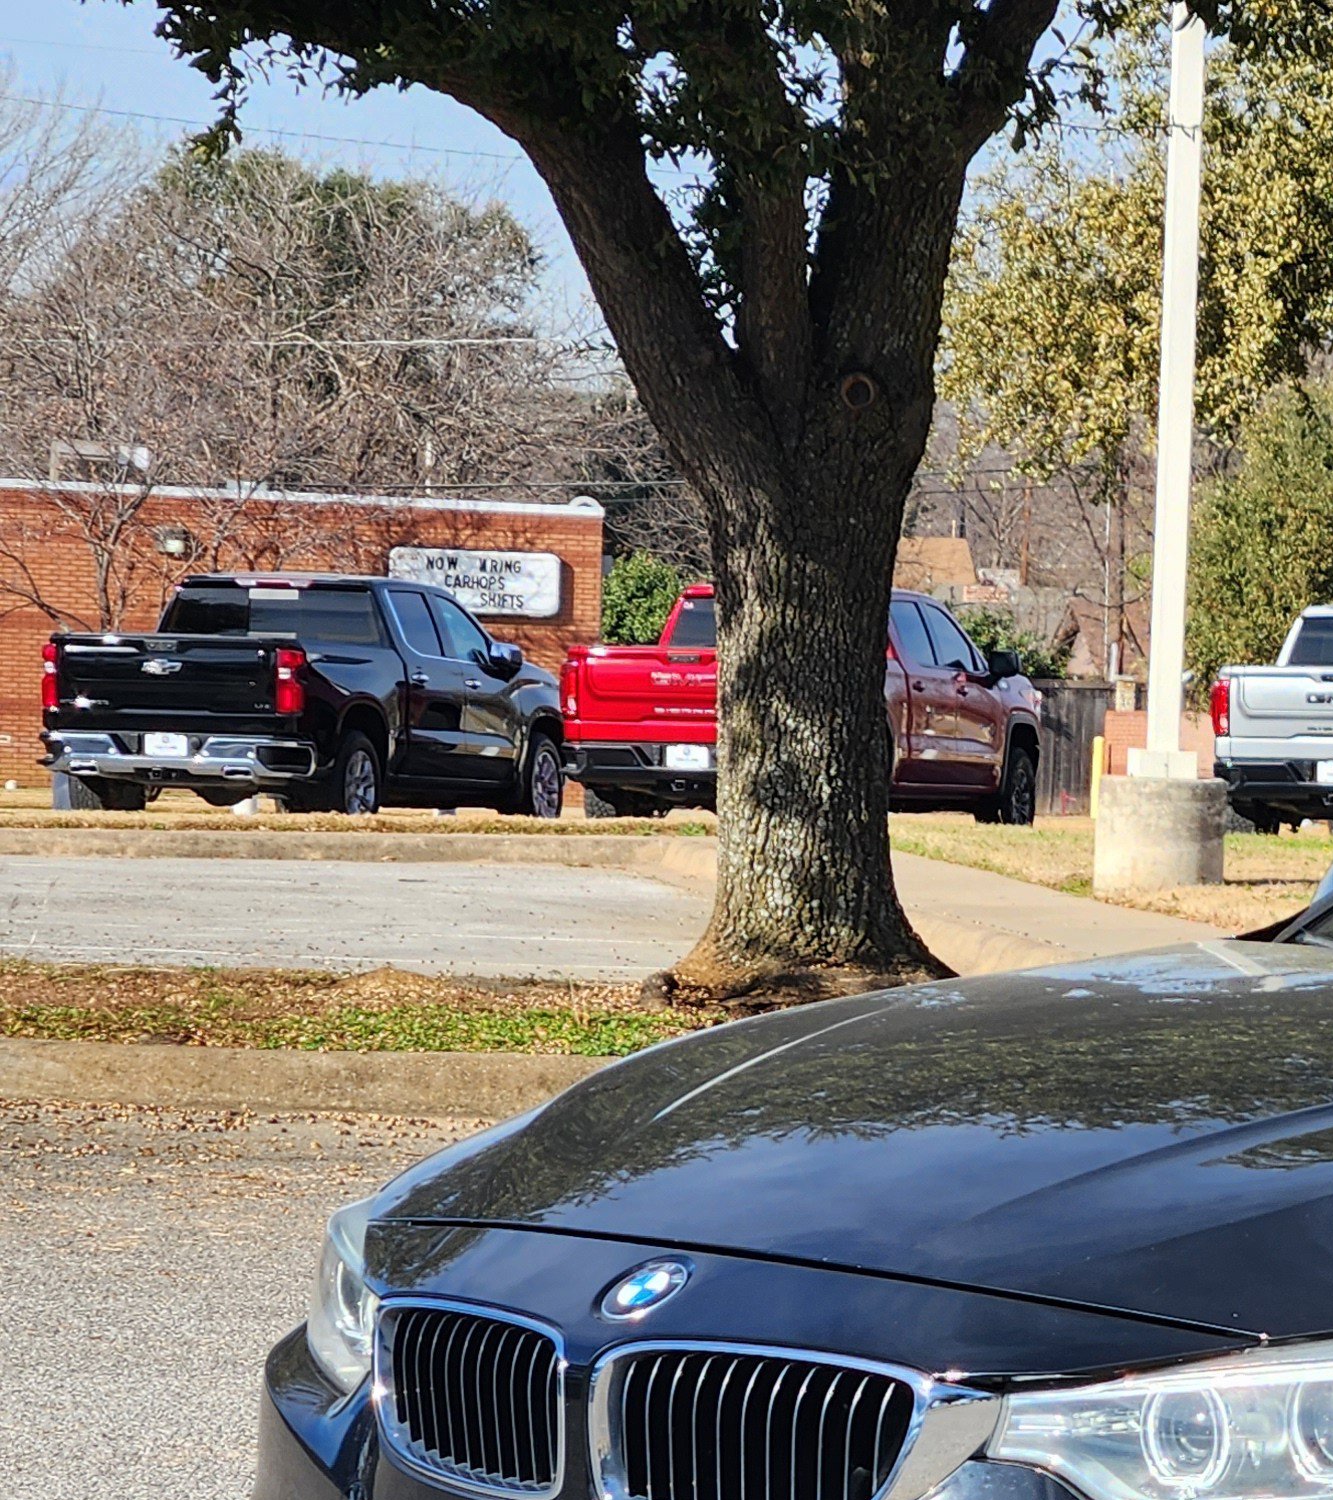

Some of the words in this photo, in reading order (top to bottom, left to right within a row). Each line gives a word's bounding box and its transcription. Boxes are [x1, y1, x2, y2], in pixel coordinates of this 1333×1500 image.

[426, 556, 459, 570] NOW
[444, 574, 505, 590] CARHOPS
[479, 592, 524, 609] SHIFTS
